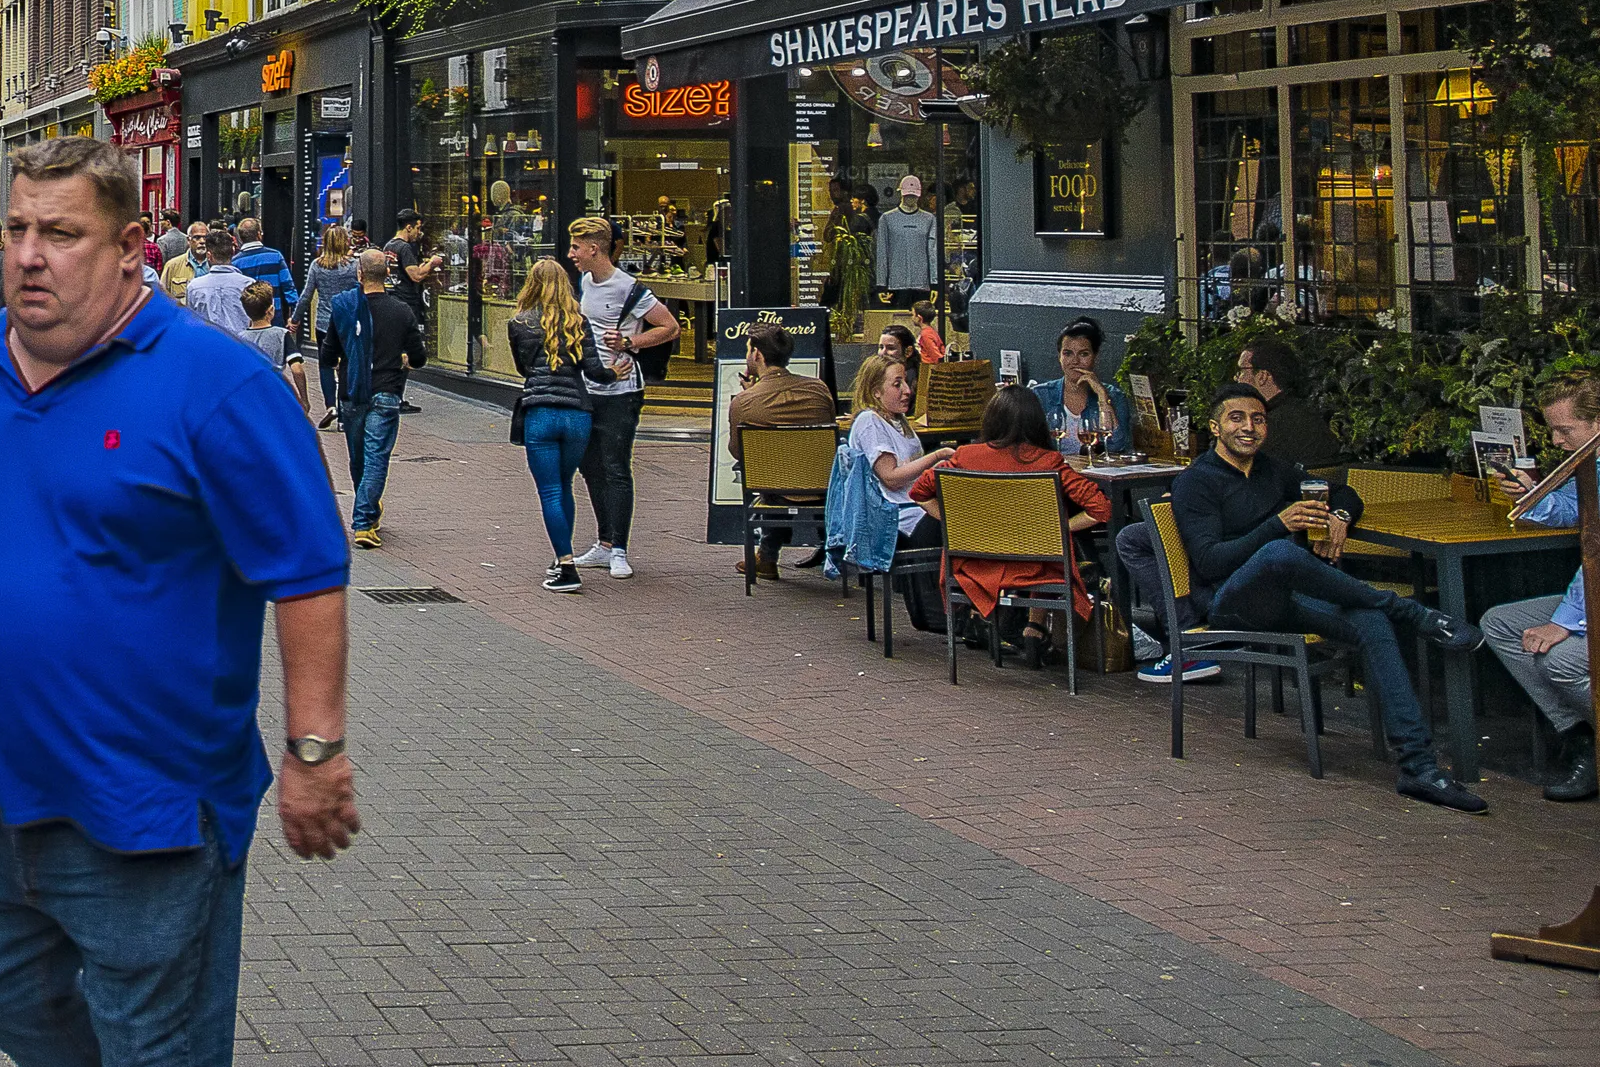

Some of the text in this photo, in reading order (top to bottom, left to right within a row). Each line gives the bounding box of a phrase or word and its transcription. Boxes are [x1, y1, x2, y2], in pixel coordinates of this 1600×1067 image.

[262, 50, 292, 93] size?
[624, 80, 731, 117] size?
[1049, 174, 1097, 198] FOOD
[1053, 202, 1073, 212] served
[757, 310, 784, 325] The
[725, 321, 817, 340] Sheare's
